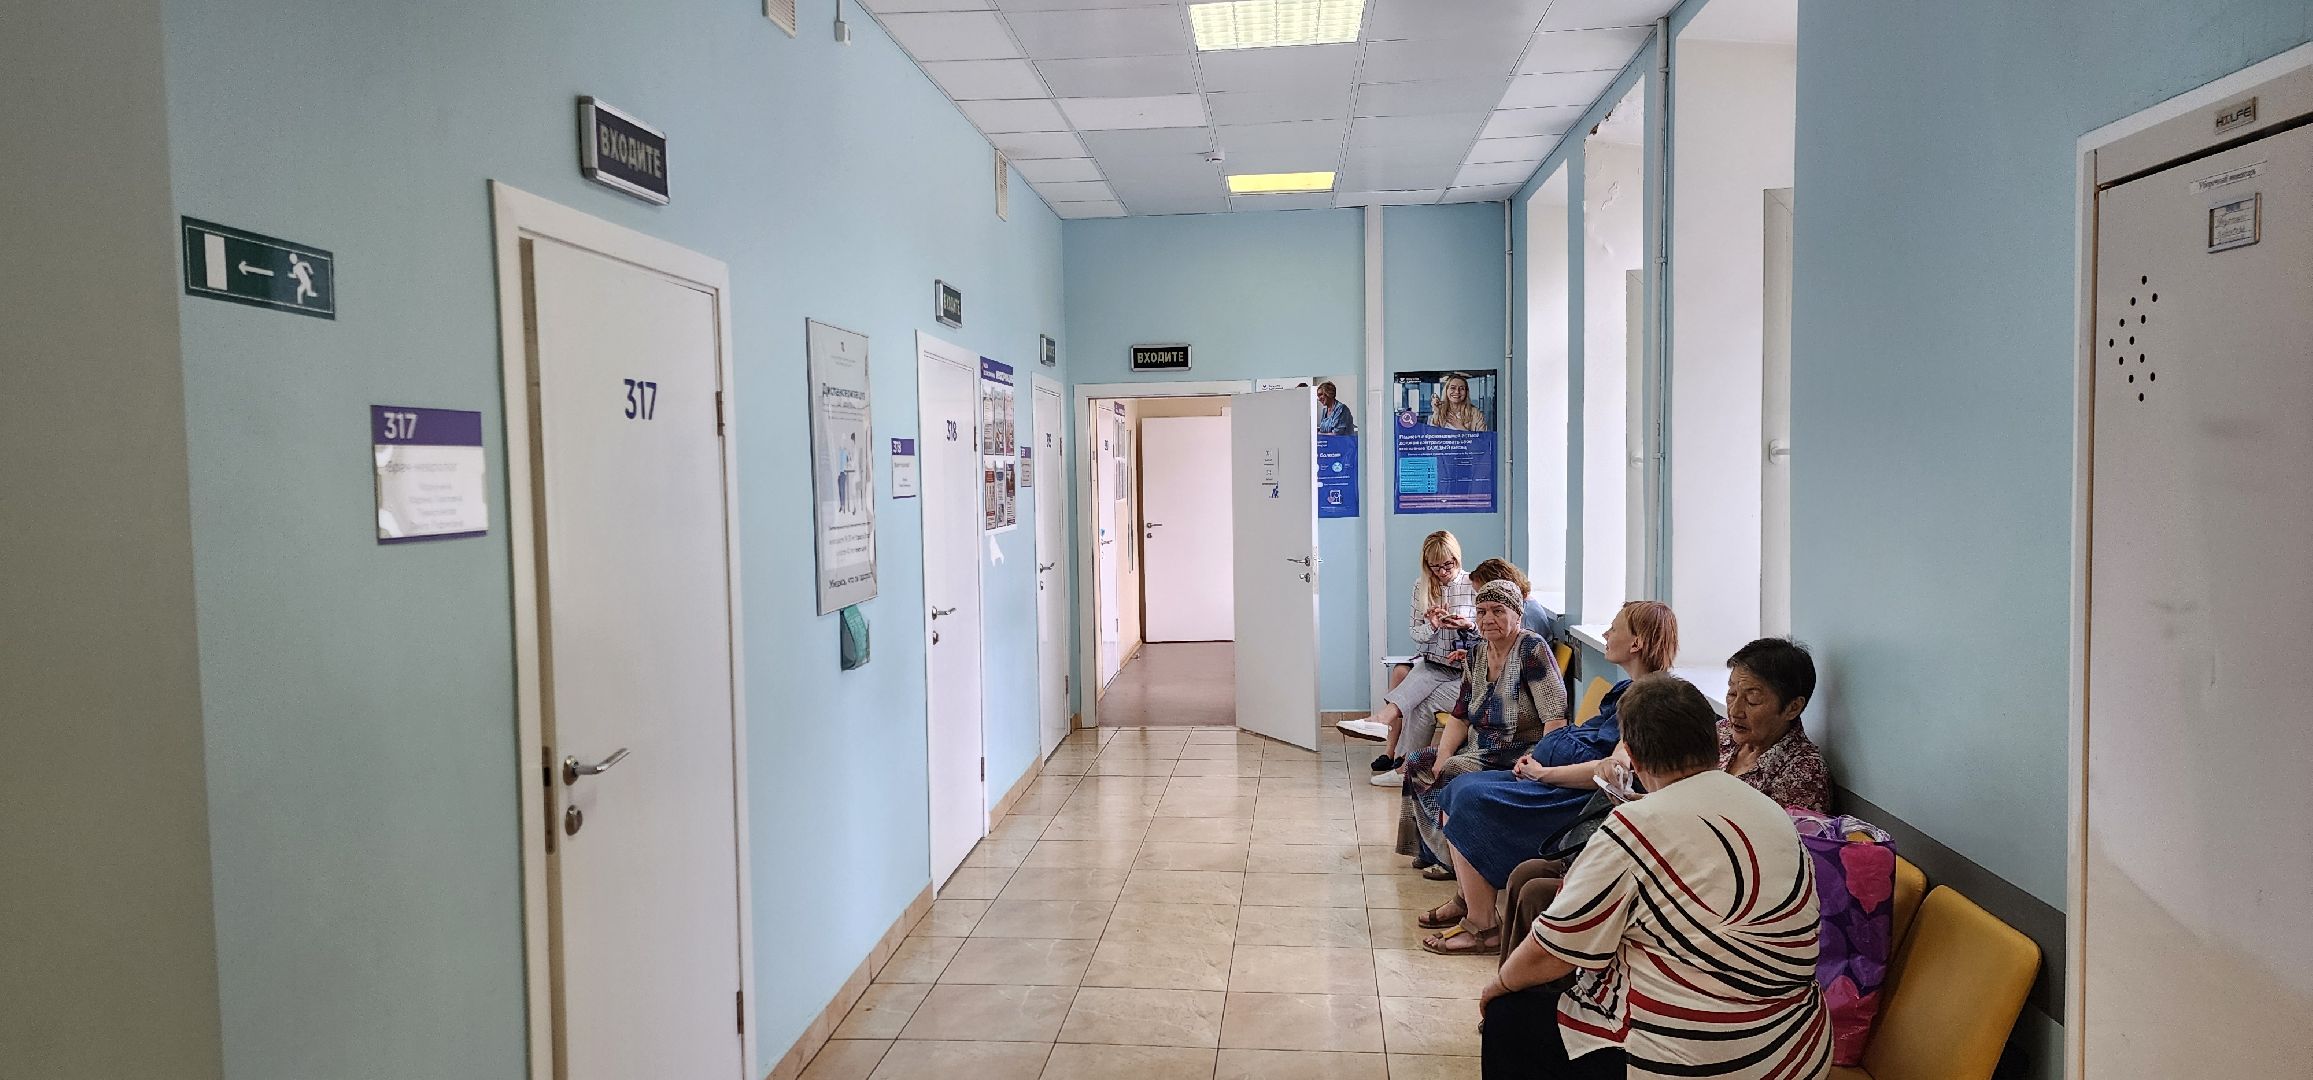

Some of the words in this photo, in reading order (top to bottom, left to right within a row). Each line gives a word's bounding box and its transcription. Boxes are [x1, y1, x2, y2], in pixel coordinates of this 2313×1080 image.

[600, 124, 662, 178] ВХОДИТЕ
[1136, 351, 1184, 364] ВХОДИТЕ
[623, 378, 657, 420] 317
[383, 411, 417, 439] 317
[946, 419, 957, 441] 318
